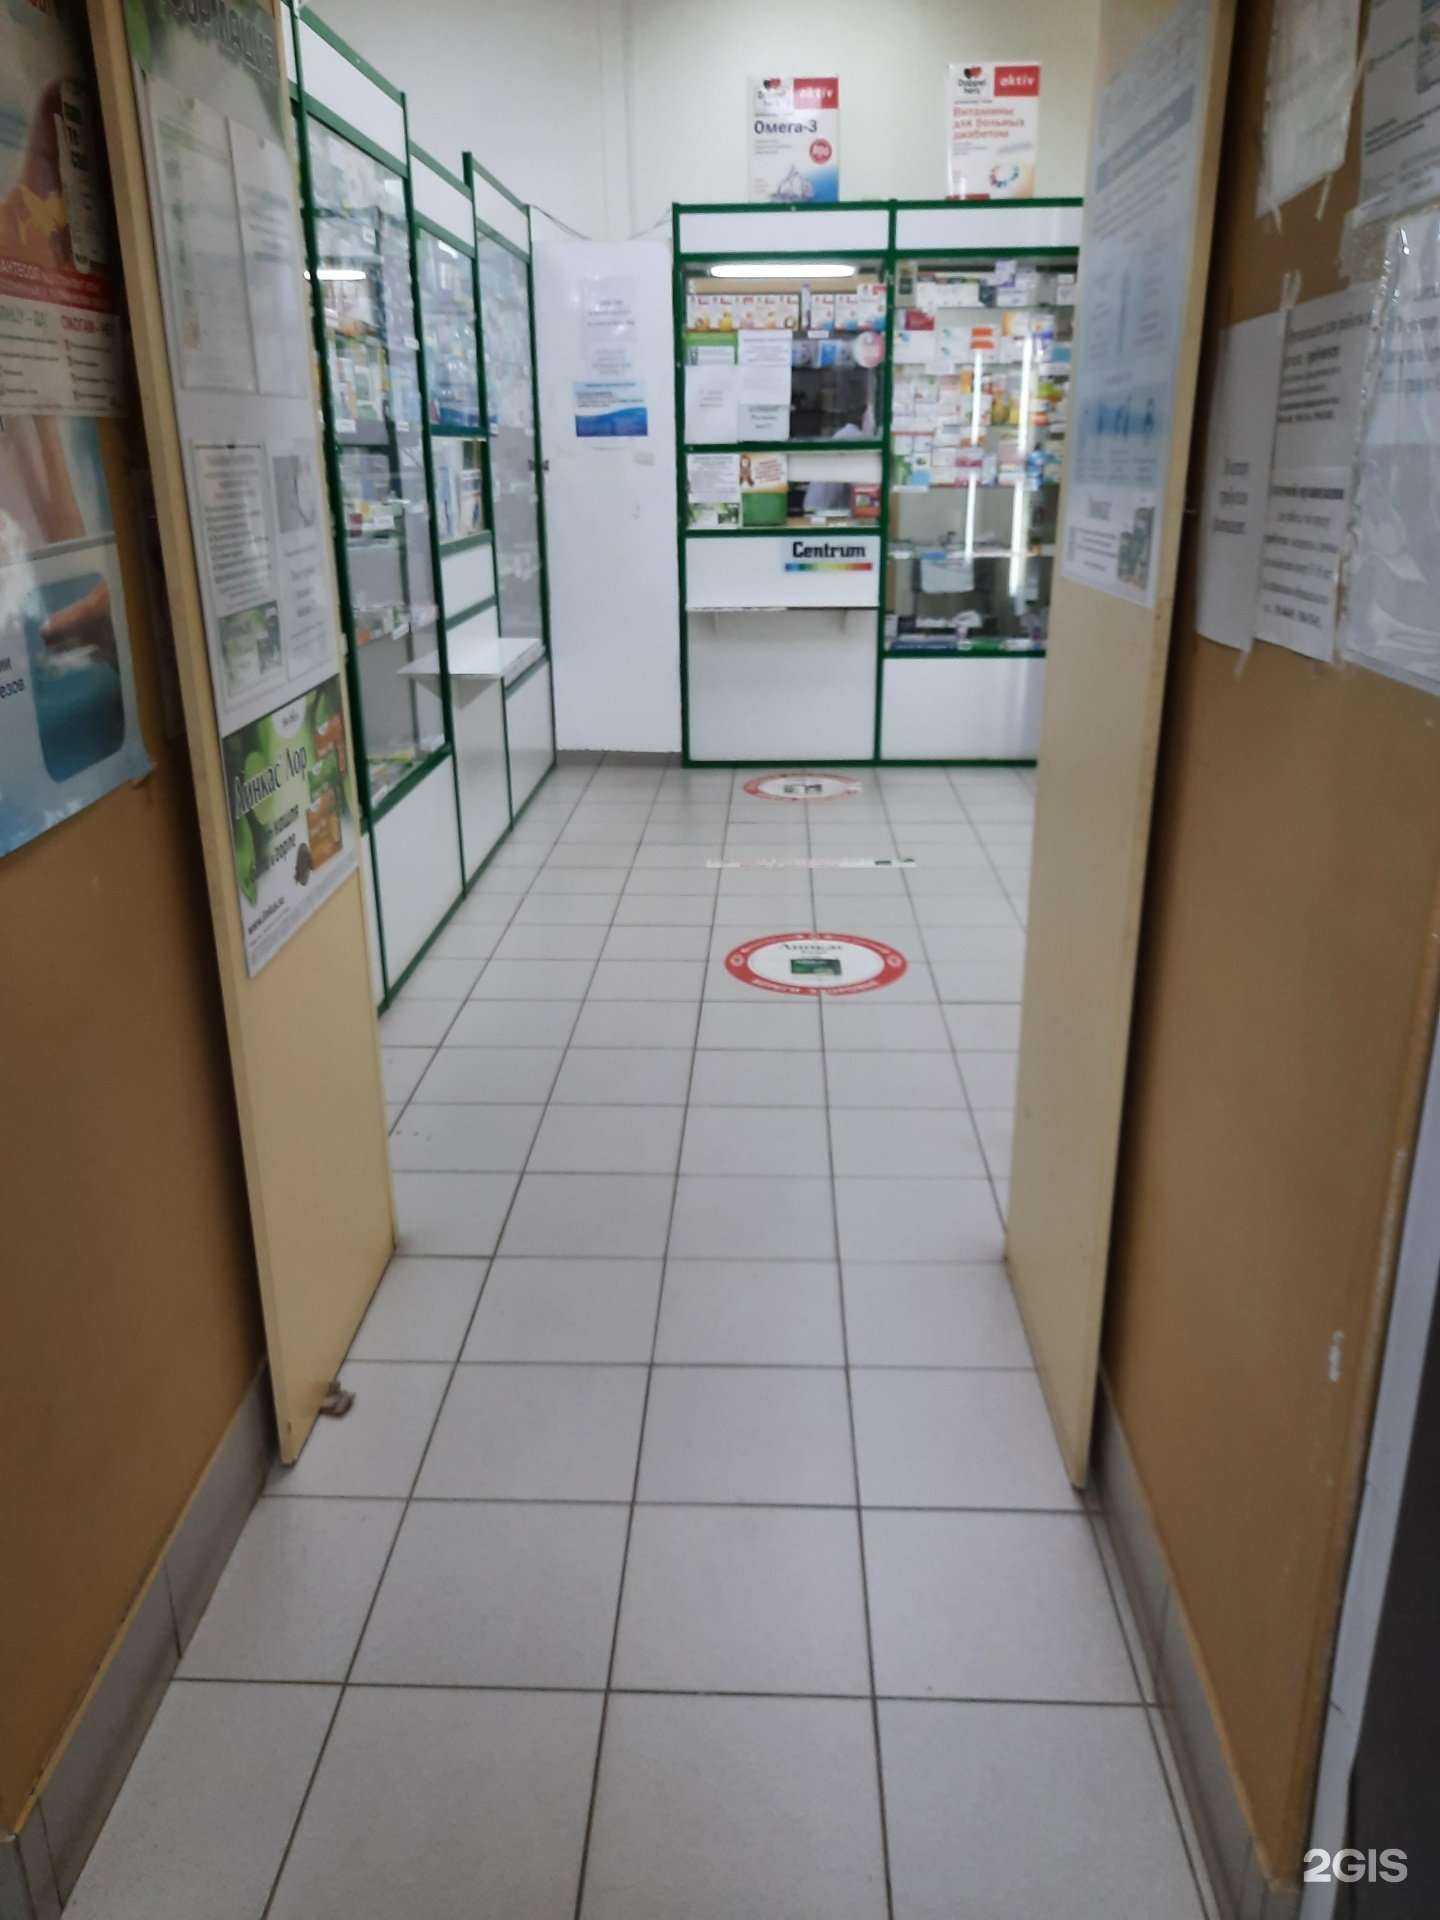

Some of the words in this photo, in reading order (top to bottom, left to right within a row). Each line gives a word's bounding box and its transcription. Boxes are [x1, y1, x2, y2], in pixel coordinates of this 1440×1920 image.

[1000, 74, 1036, 87] aktiv
[754, 119, 818, 134] Омега-3
[792, 541, 866, 558] Centrum
